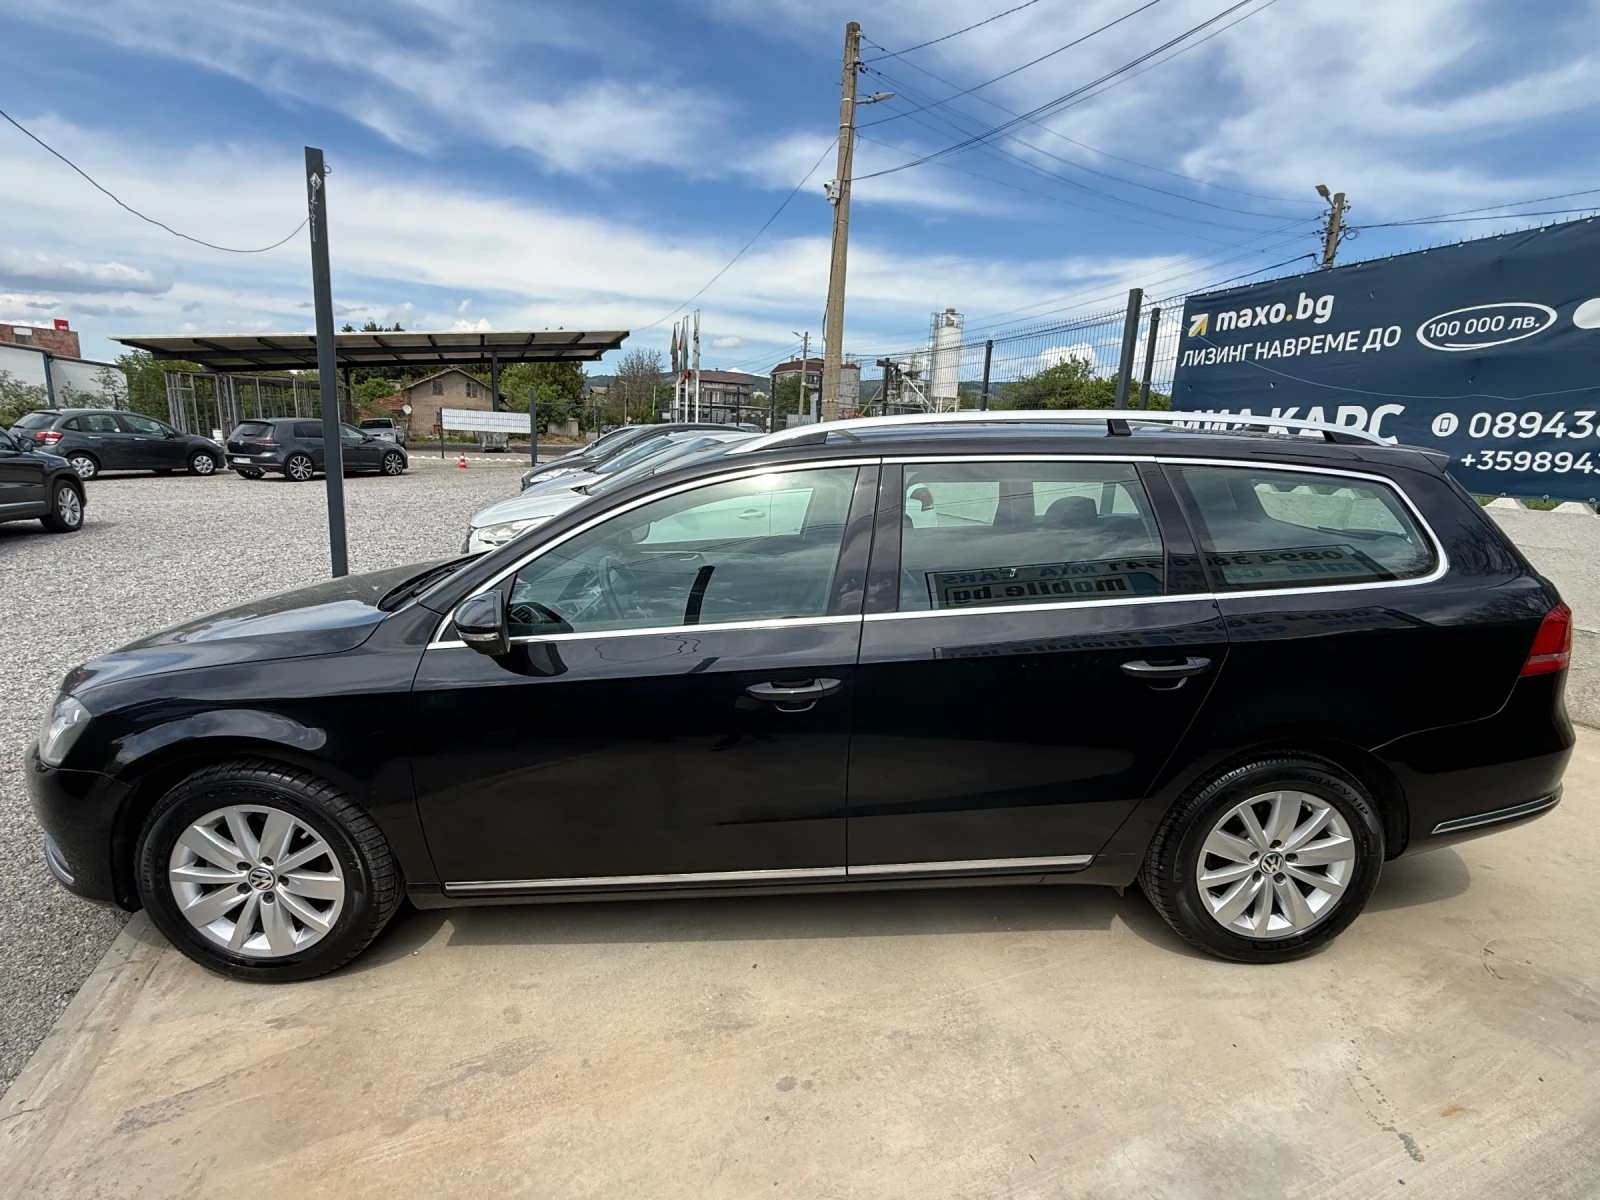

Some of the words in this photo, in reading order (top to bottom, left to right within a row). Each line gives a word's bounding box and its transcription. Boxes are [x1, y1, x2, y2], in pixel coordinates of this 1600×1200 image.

[1215, 292, 1335, 332] maxo.bg
[1429, 320, 1461, 338] 100
[1464, 315, 1505, 334] 000
[1508, 316, 1540, 330] лв.
[1181, 343, 1253, 367] ЛИЗИНГ
[1254, 330, 1361, 360] НАВРЕМЕ
[1362, 325, 1402, 352] ДО
[1468, 410, 1600, 439] 08943
